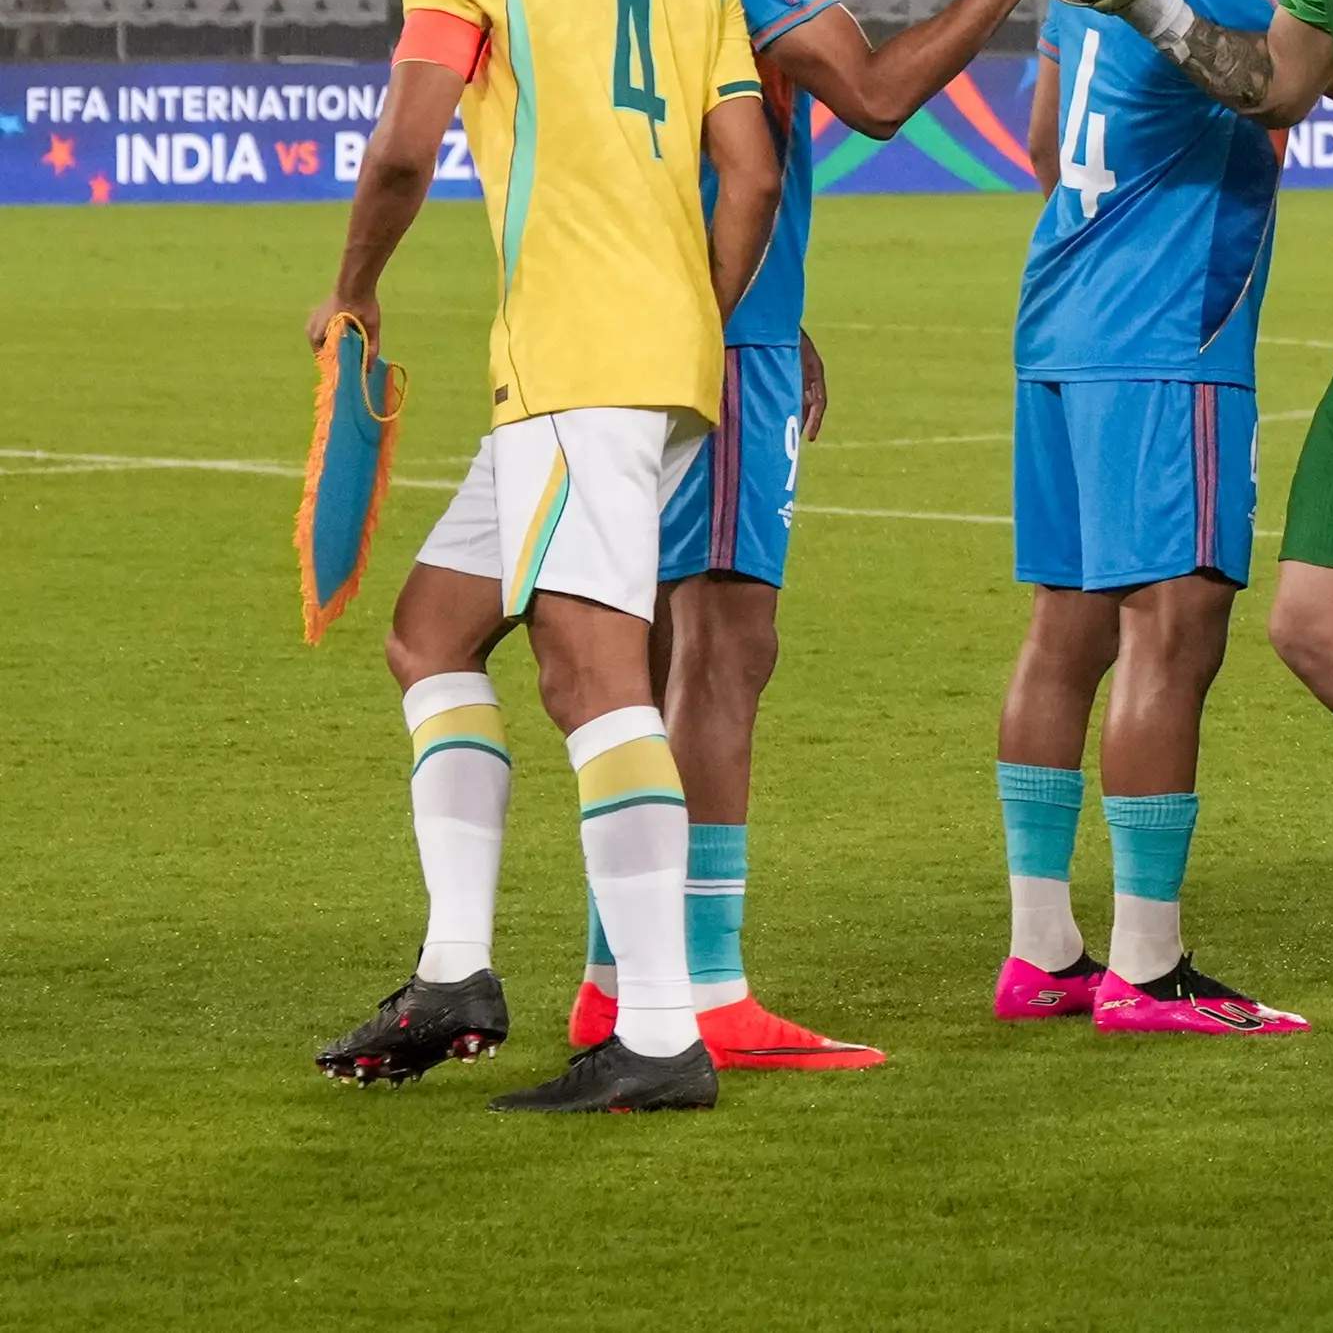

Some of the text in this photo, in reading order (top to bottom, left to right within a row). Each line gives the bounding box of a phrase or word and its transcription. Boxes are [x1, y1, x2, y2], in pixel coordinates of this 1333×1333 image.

[26, 85, 388, 125] FIFA INTERNATION
[1058, 28, 1116, 219] 4
[116, 132, 268, 186] INDIA
